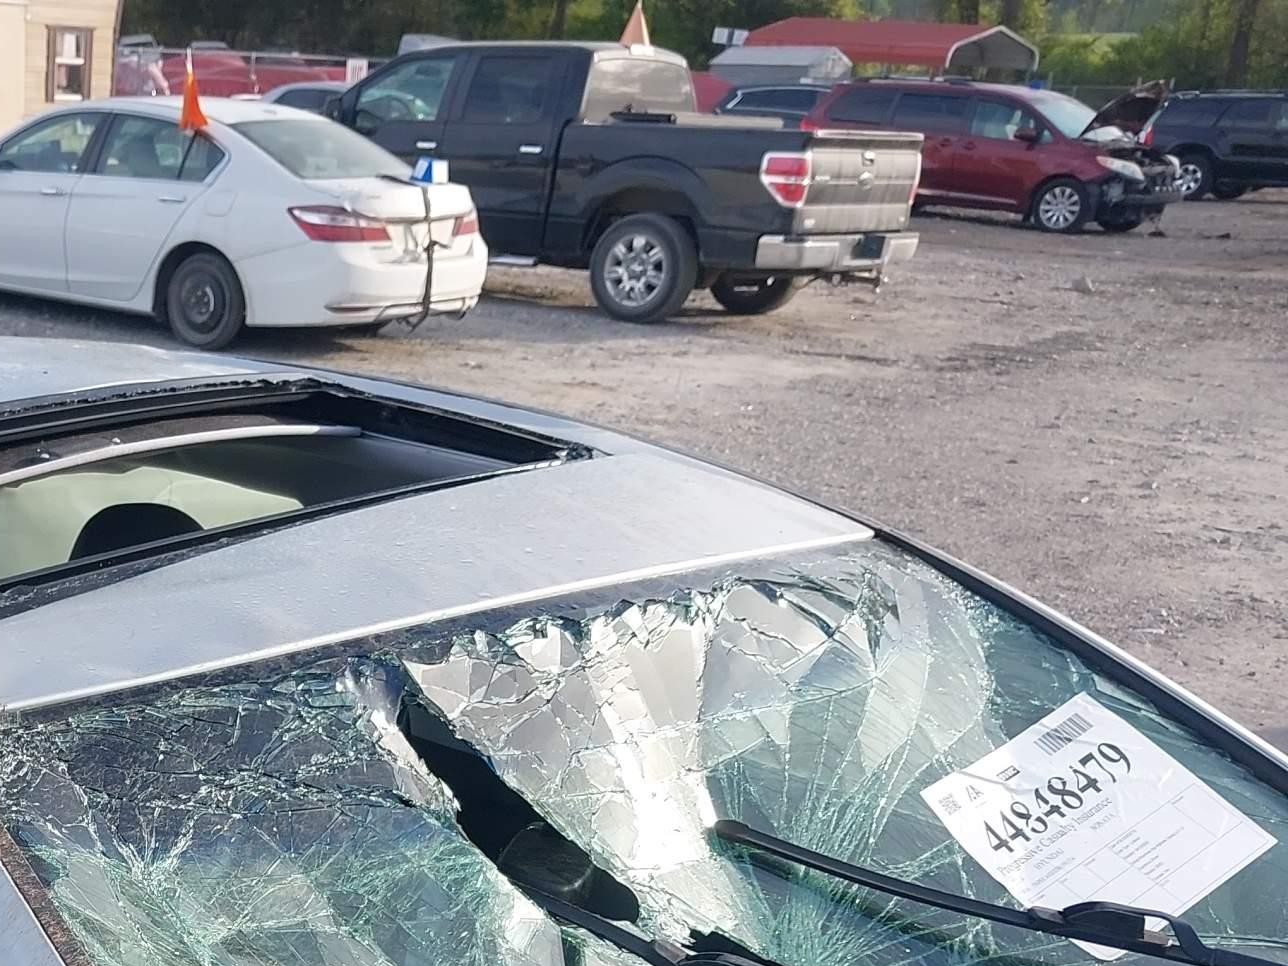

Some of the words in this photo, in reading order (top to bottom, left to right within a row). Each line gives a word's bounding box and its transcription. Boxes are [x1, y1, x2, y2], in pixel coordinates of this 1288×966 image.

[983, 742, 1131, 853] 44848479
[997, 845, 1044, 875] Progressive
[1039, 823, 1077, 848] Casualty
[1072, 797, 1113, 827] Insurance
